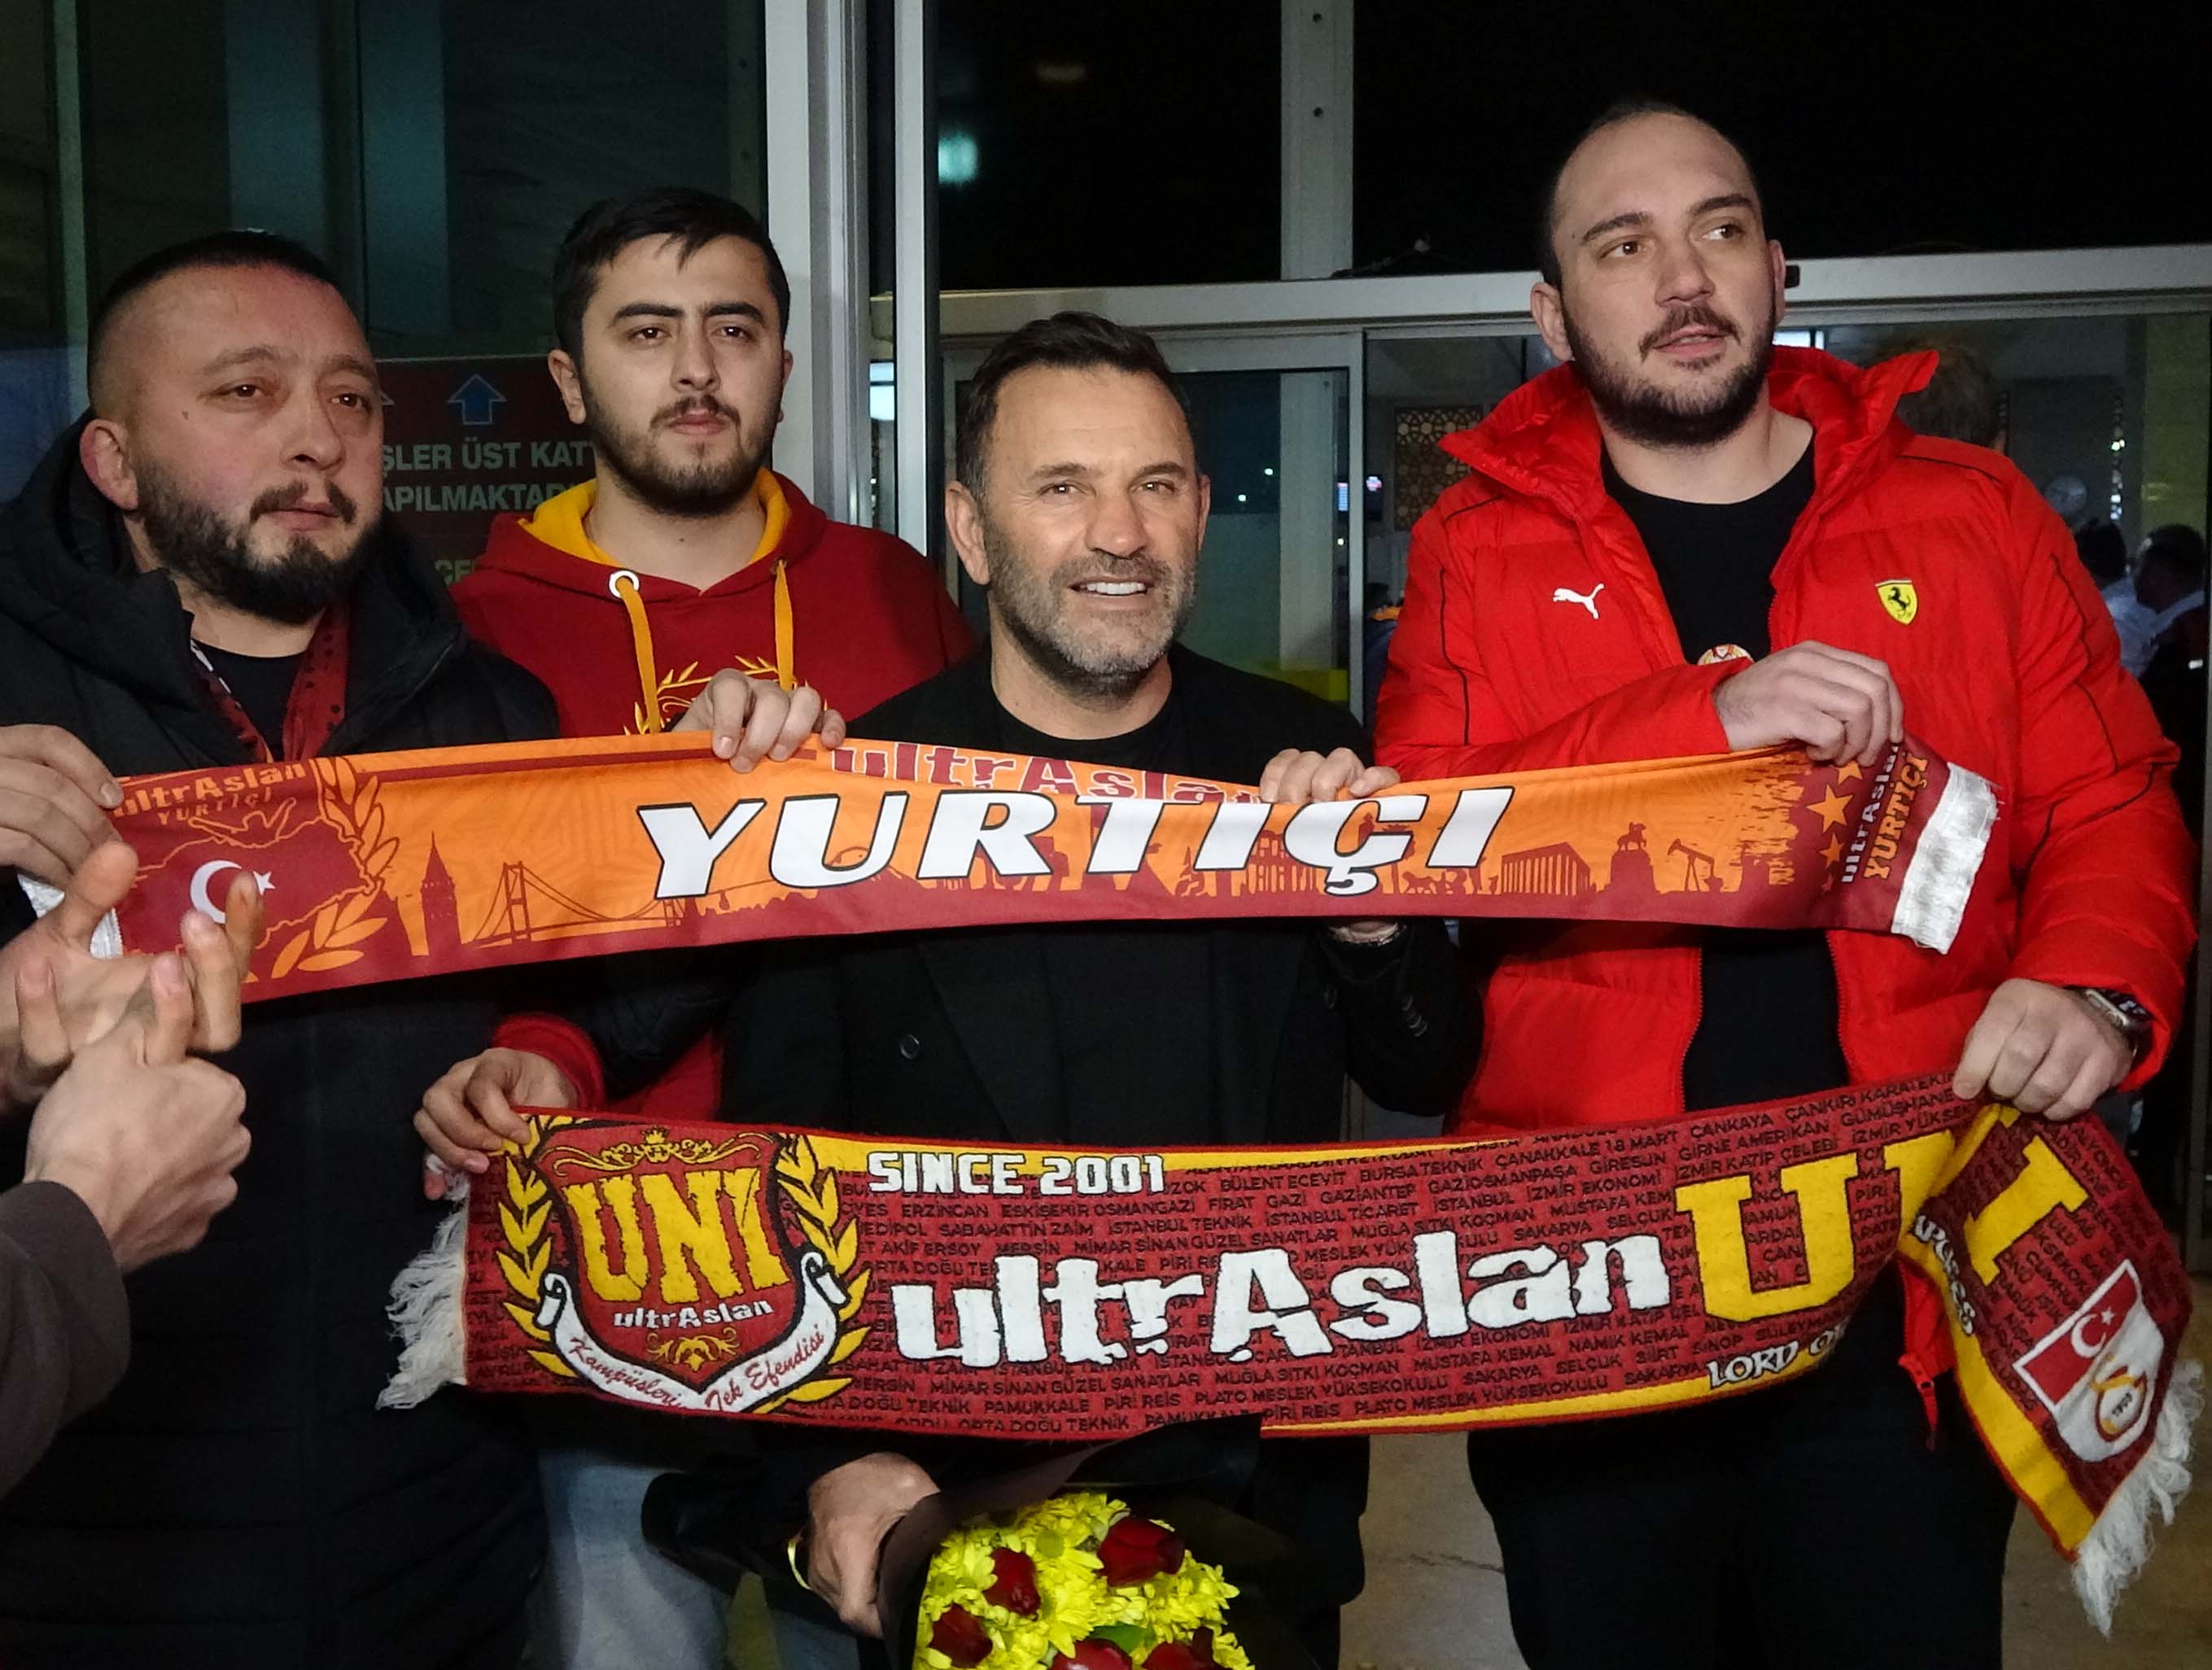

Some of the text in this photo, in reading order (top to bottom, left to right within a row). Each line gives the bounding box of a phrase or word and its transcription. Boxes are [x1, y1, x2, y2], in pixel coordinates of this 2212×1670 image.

[461, 436, 522, 470] ÜST
[530, 440, 597, 469] KAT
[1359, 1165, 1419, 1181] BURSA
[1606, 1139, 1625, 1152] 18
[1630, 1130, 1678, 1150] MART
[868, 1151, 1165, 1196] SINCE 2001
[901, 1200, 990, 1218] ERZİNCAN
[1093, 1197, 1196, 1217] OSMANGAZİ
[938, 1220, 1047, 1237] SABAHATTİN
[1108, 1218, 1188, 1235] İSTANBUL
[1348, 1201, 1419, 1219] TİCARET
[1513, 1219, 1593, 1242] SAKARYA
[924, 1241, 981, 1257] ERSOY
[614, 1300, 773, 1328] ultrAslan
[890, 1229, 1672, 1369] ultrAslan
[1497, 1344, 1556, 1364] KEMAL
[1707, 1340, 1799, 1389] LORD
